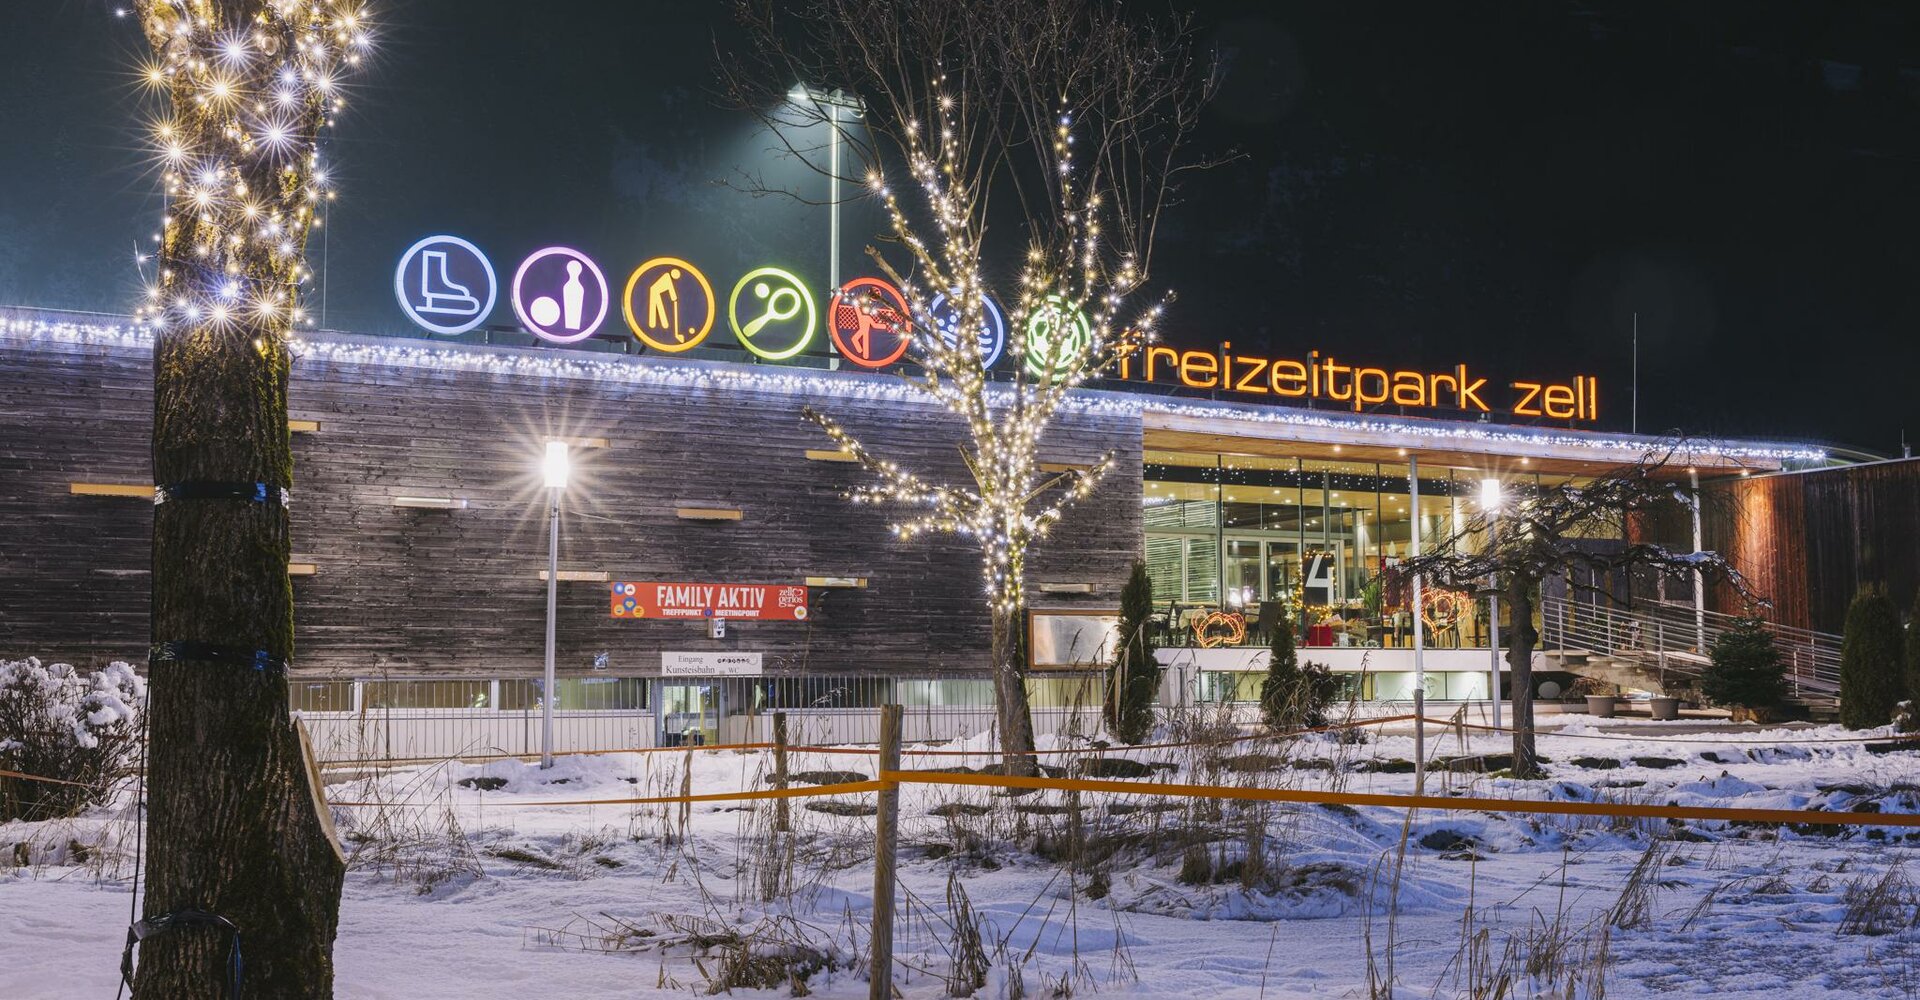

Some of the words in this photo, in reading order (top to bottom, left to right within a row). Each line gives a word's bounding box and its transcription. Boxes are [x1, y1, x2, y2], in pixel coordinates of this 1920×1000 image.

[1116, 330, 1489, 412] freizeitpark
[1513, 376, 1597, 420] zell
[1305, 555, 1334, 607] 4
[656, 585, 713, 608] FAMILY
[718, 587, 765, 608] AKTIV
[662, 608, 702, 617] TREFFPUNKT
[715, 608, 760, 617] MEETINGPOINT
[678, 655, 704, 664] Eingang
[665, 665, 715, 674] Kunsteisbahn
